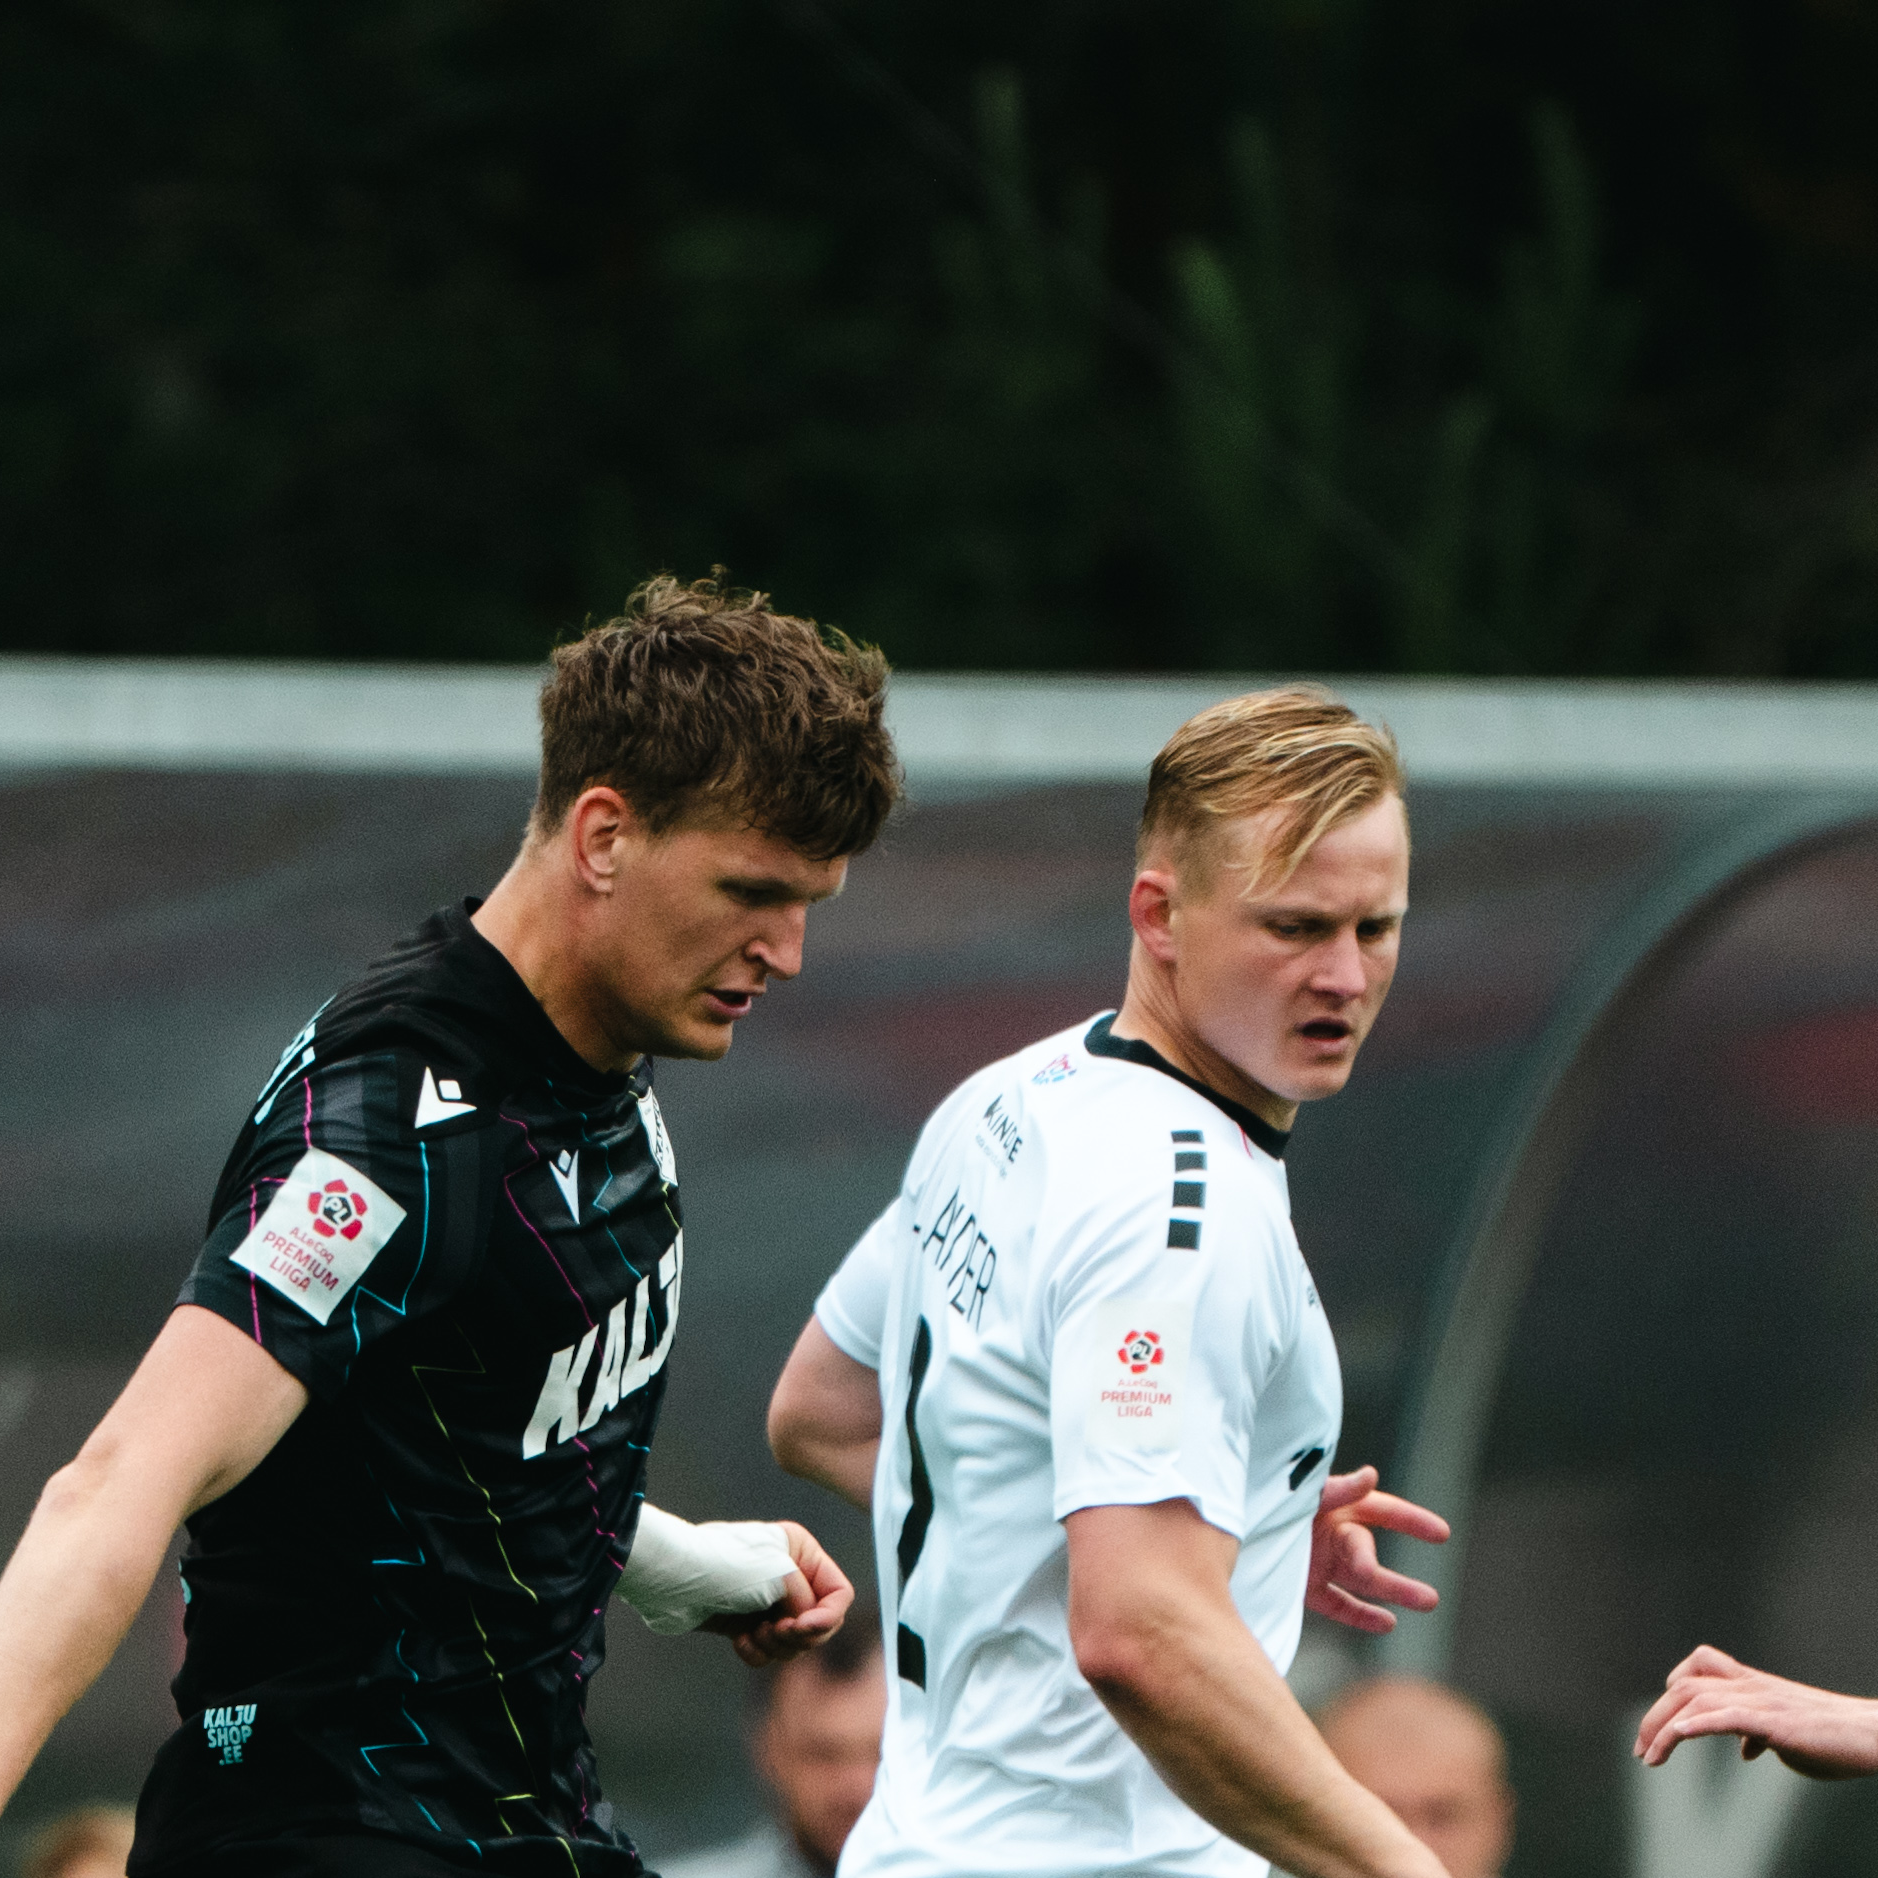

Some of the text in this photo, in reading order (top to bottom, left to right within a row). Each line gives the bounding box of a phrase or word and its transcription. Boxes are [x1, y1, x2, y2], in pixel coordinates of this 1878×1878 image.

[262, 1231, 340, 1291] PREMIUM
[269, 1256, 312, 1292] LIIGA
[523, 1228, 684, 1460] KALJ
[1101, 1390, 1172, 1405] PREMIUM
[1117, 1405, 1153, 1417] LIIGA
[204, 1704, 258, 1729] KALJU
[207, 1725, 253, 1748] SHOP
[219, 1745, 243, 1766] .EE
